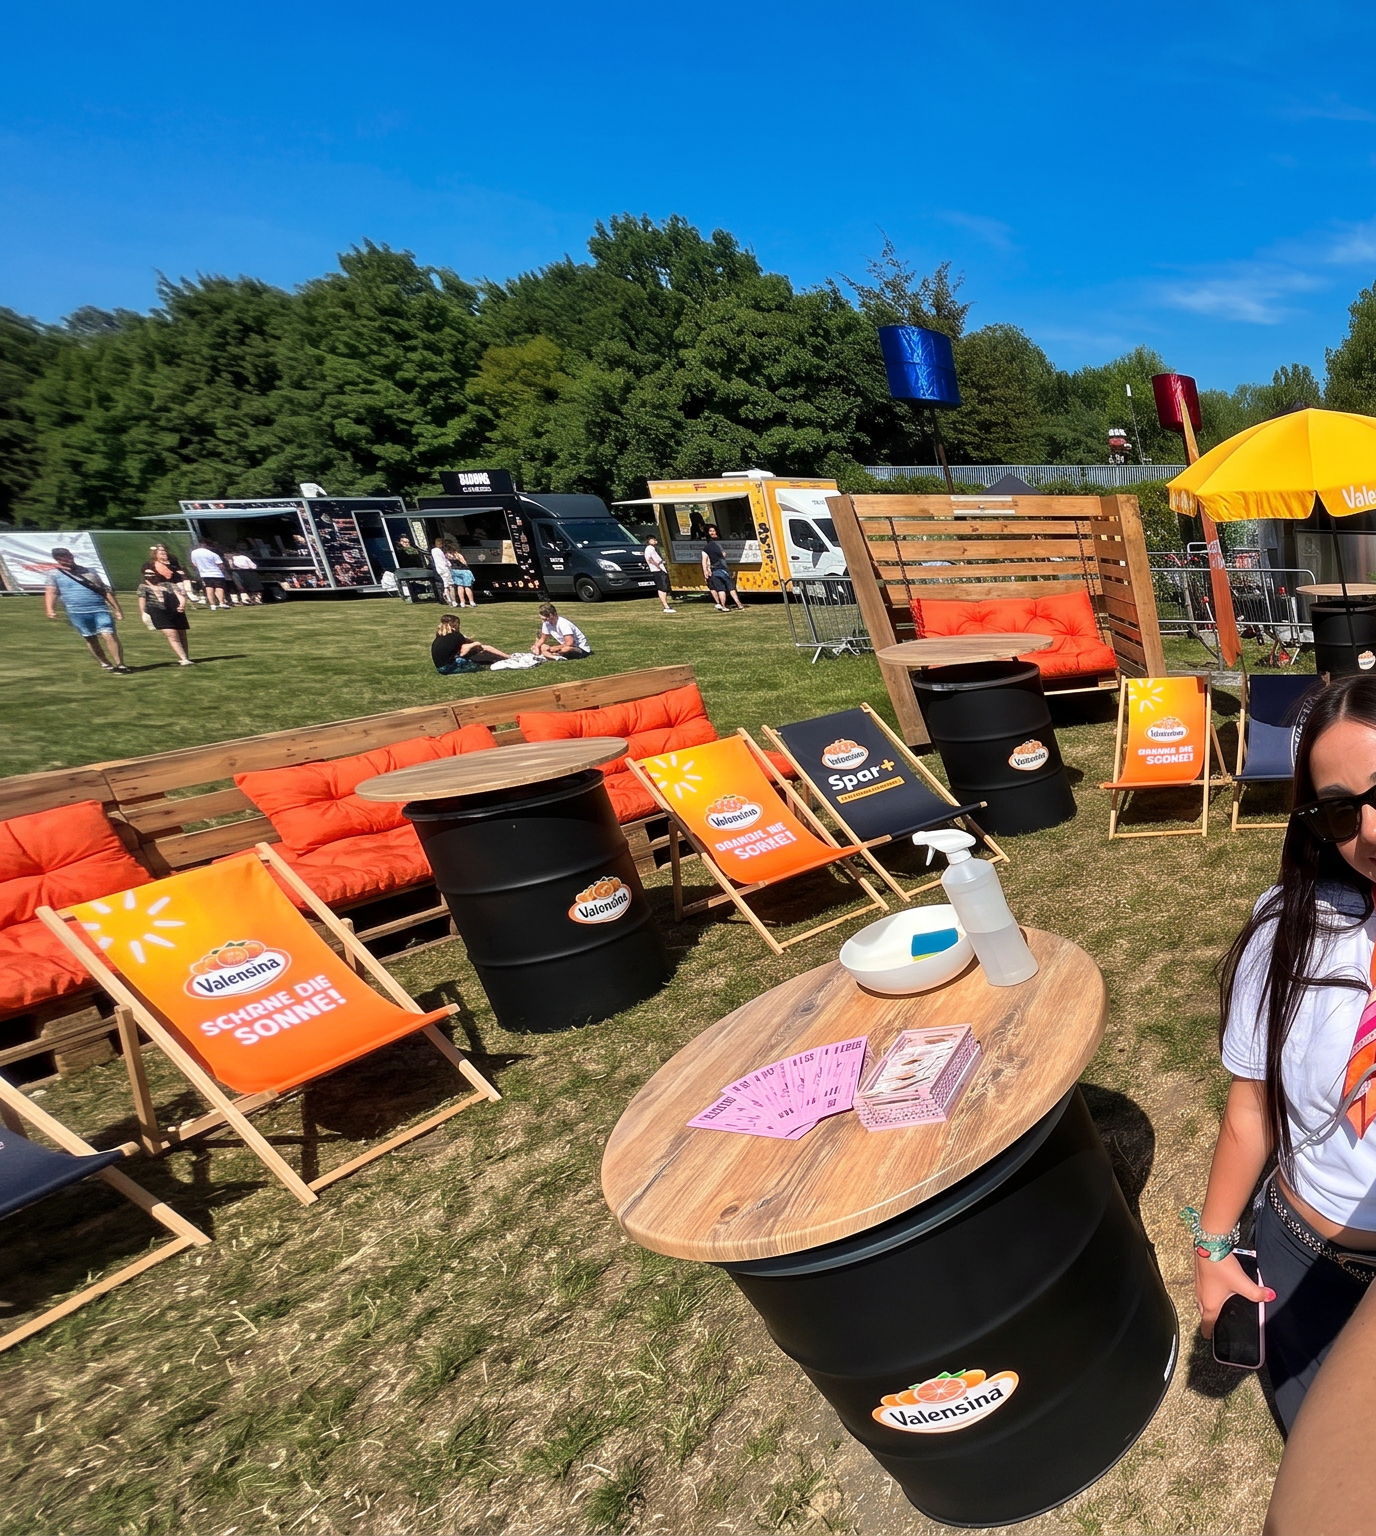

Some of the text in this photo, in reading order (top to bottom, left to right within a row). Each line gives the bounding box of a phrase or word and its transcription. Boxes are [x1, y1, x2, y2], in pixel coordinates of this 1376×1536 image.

[828, 759, 896, 791] Spar+
[196, 958, 281, 993] Valensina
[293, 974, 332, 997] DIE
[233, 988, 347, 1045] SONNE!
[889, 1386, 1004, 1426] Valensina
